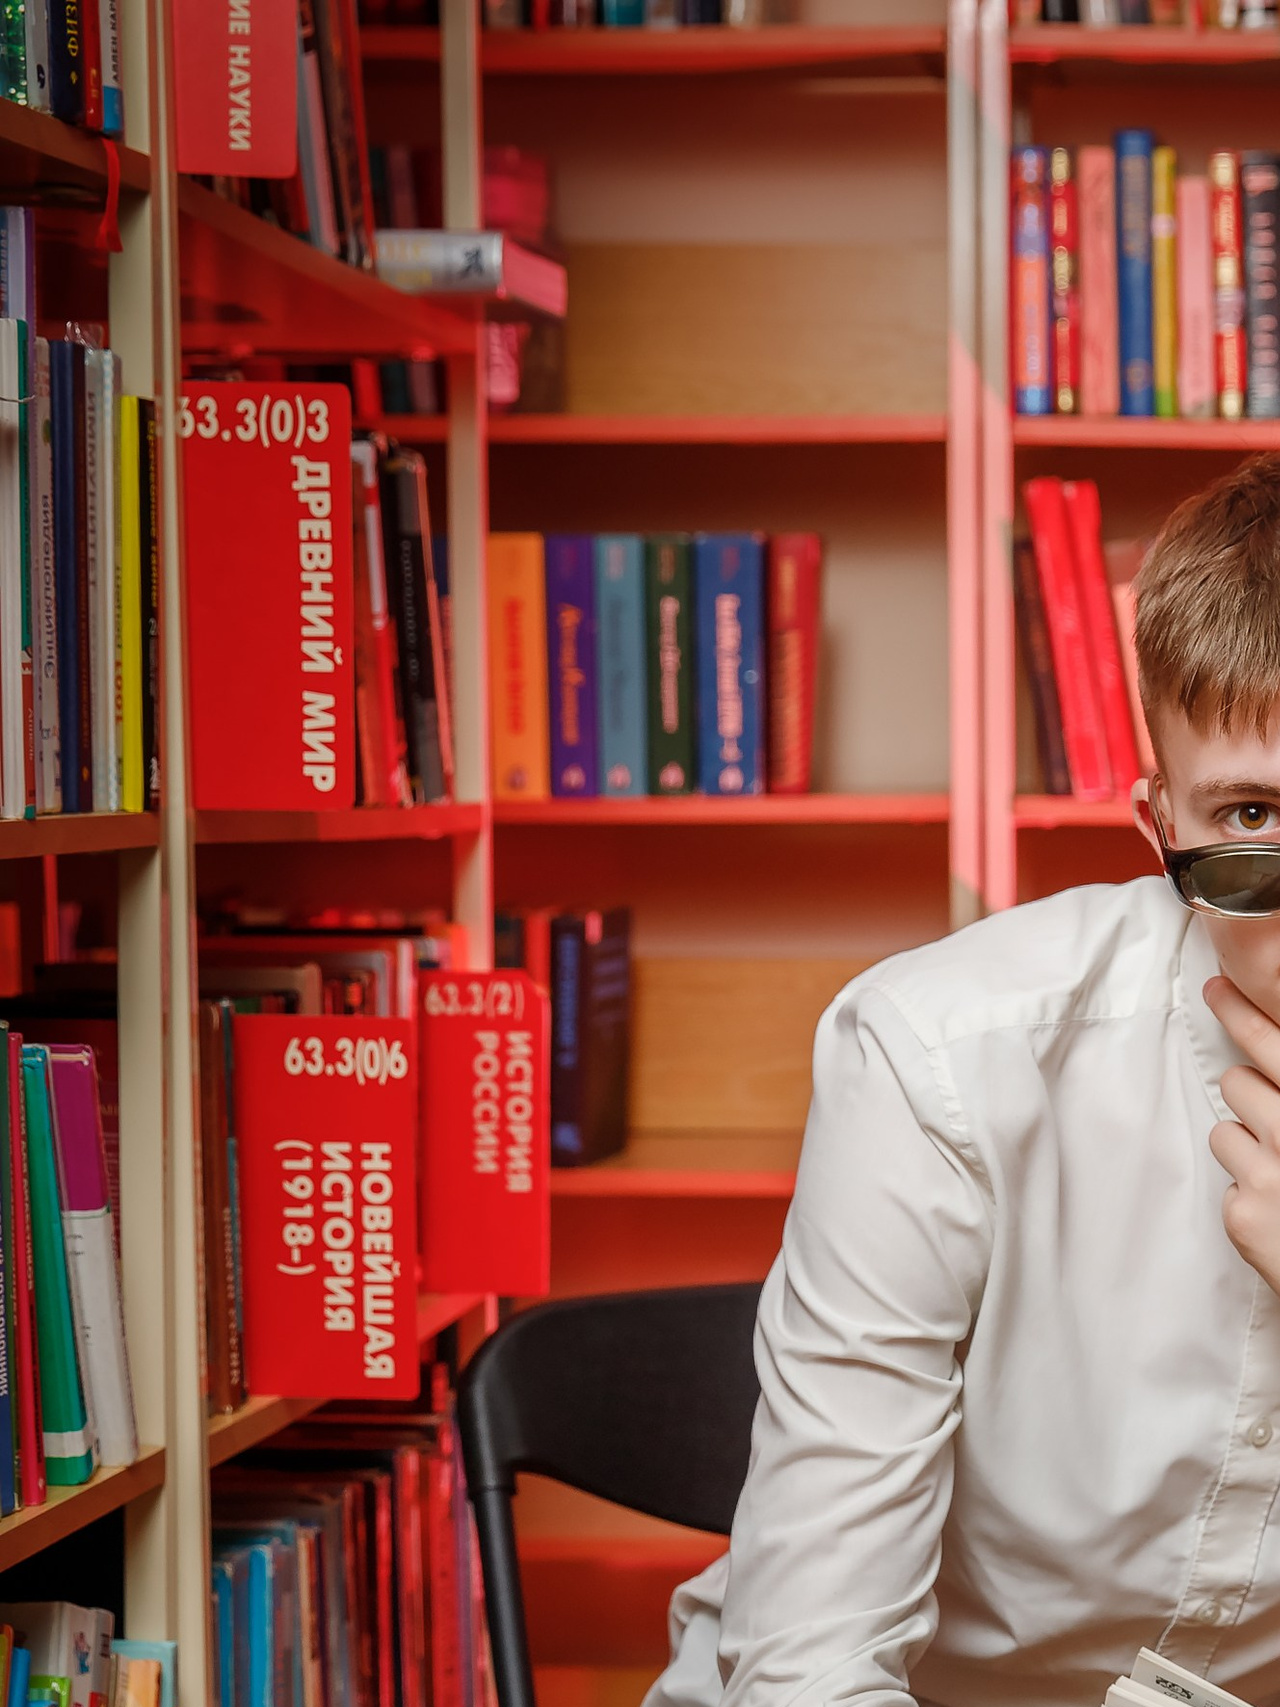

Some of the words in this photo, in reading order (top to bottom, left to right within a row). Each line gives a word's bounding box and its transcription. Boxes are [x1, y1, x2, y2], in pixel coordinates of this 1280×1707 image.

[65, 0, 79, 57] ФИЗ
[228, 44, 252, 150] НАУКИ
[41, 494, 55, 681] Энциклопедия
[291, 455, 343, 673] ДРЕВНИЙ
[301, 690, 336, 792] МИР
[284, 1037, 408, 1085] 63.3(0)6
[425, 981, 525, 1021] 63.3(2)
[472, 1030, 500, 1174] РОССИИ
[505, 1030, 534, 1193] ИСТОРИЯ
[273, 1139, 317, 1276] (1918-)
[321, 1141, 355, 1331] ИСТОРИЯ
[360, 1141, 402, 1380] НОВЕЙШАЯ
